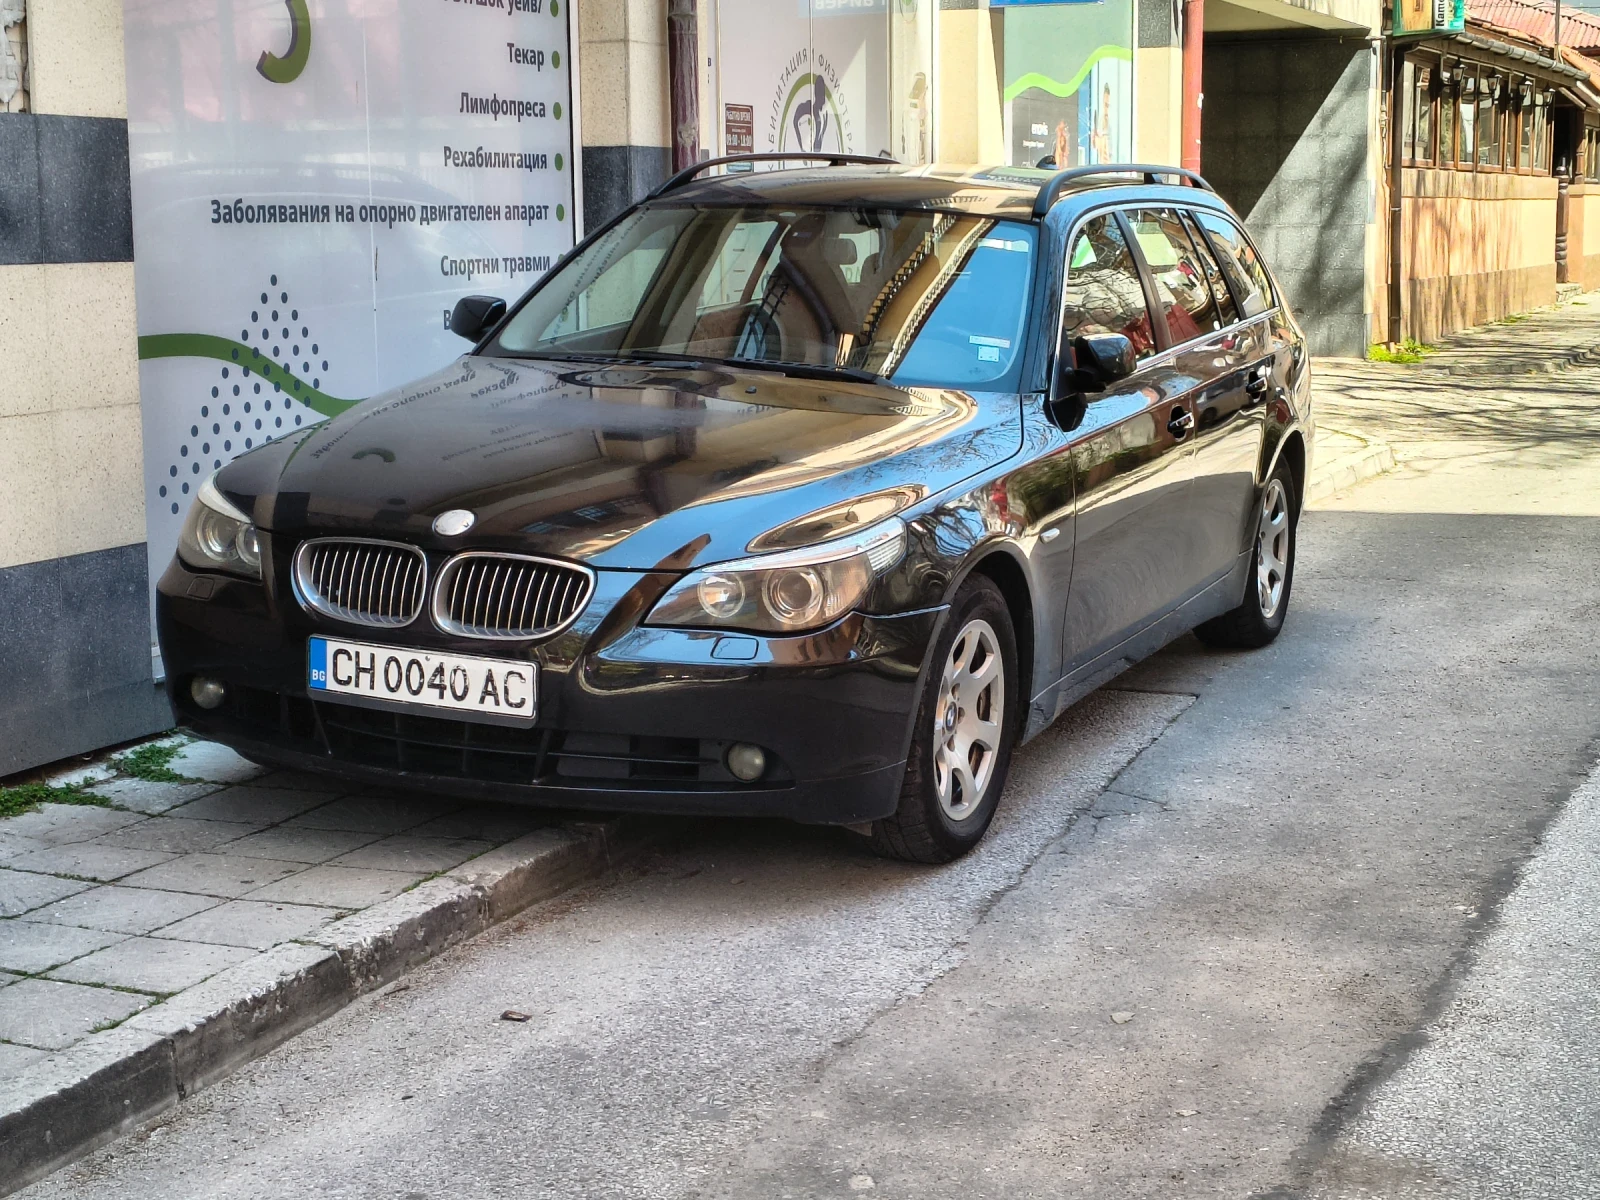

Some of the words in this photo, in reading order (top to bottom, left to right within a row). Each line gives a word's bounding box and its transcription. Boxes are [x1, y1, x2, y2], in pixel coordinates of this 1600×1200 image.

[506, 42, 545, 72] Текар
[459, 92, 546, 122] Лимфопреса
[443, 146, 548, 172] Рехабилитация
[210, 198, 331, 224] Заболявания
[335, 204, 355, 223] на
[359, 204, 416, 229] опорно
[419, 203, 501, 226] двигателен
[504, 203, 550, 227] апарат
[440, 255, 499, 281] Спортни
[502, 255, 551, 279] травми
[312, 668, 326, 681] BG
[332, 648, 376, 691] CH
[383, 655, 470, 702] 0040
[478, 668, 527, 709] AC
